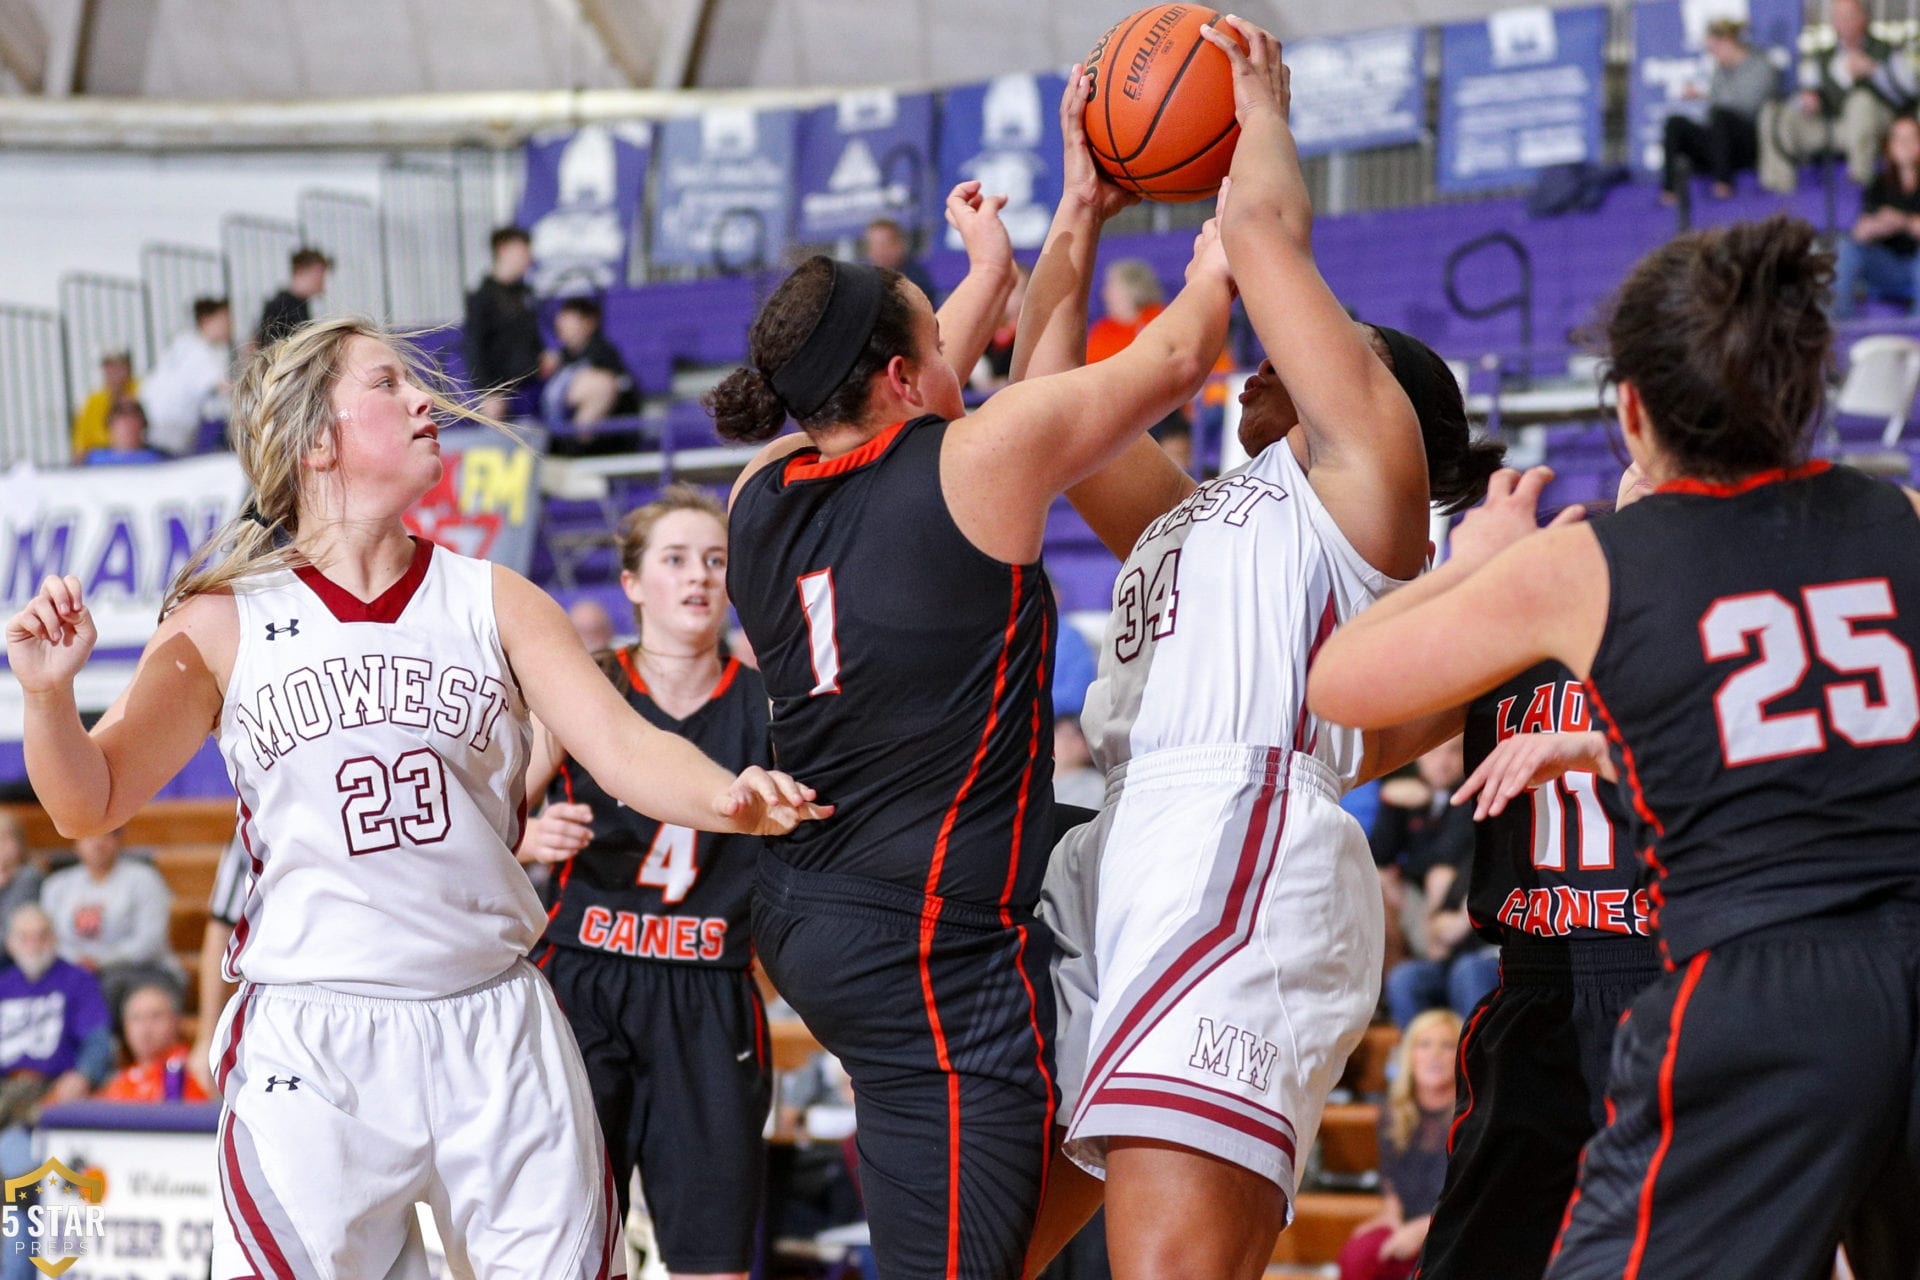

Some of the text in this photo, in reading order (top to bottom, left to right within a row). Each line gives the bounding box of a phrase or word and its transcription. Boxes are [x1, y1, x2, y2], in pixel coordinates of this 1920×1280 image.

[1123, 6, 1187, 100] EVOLUTION
[459, 448, 528, 526] FM
[796, 566, 842, 697] 1
[1115, 548, 1182, 664] 34
[236, 655, 509, 770] MOWEST
[1697, 576, 1920, 768] 25
[335, 747, 451, 856] 23
[1526, 768, 1615, 872] 11
[635, 822, 699, 904] 4
[579, 906, 727, 960] CANES
[1189, 1017, 1278, 1092] MW
